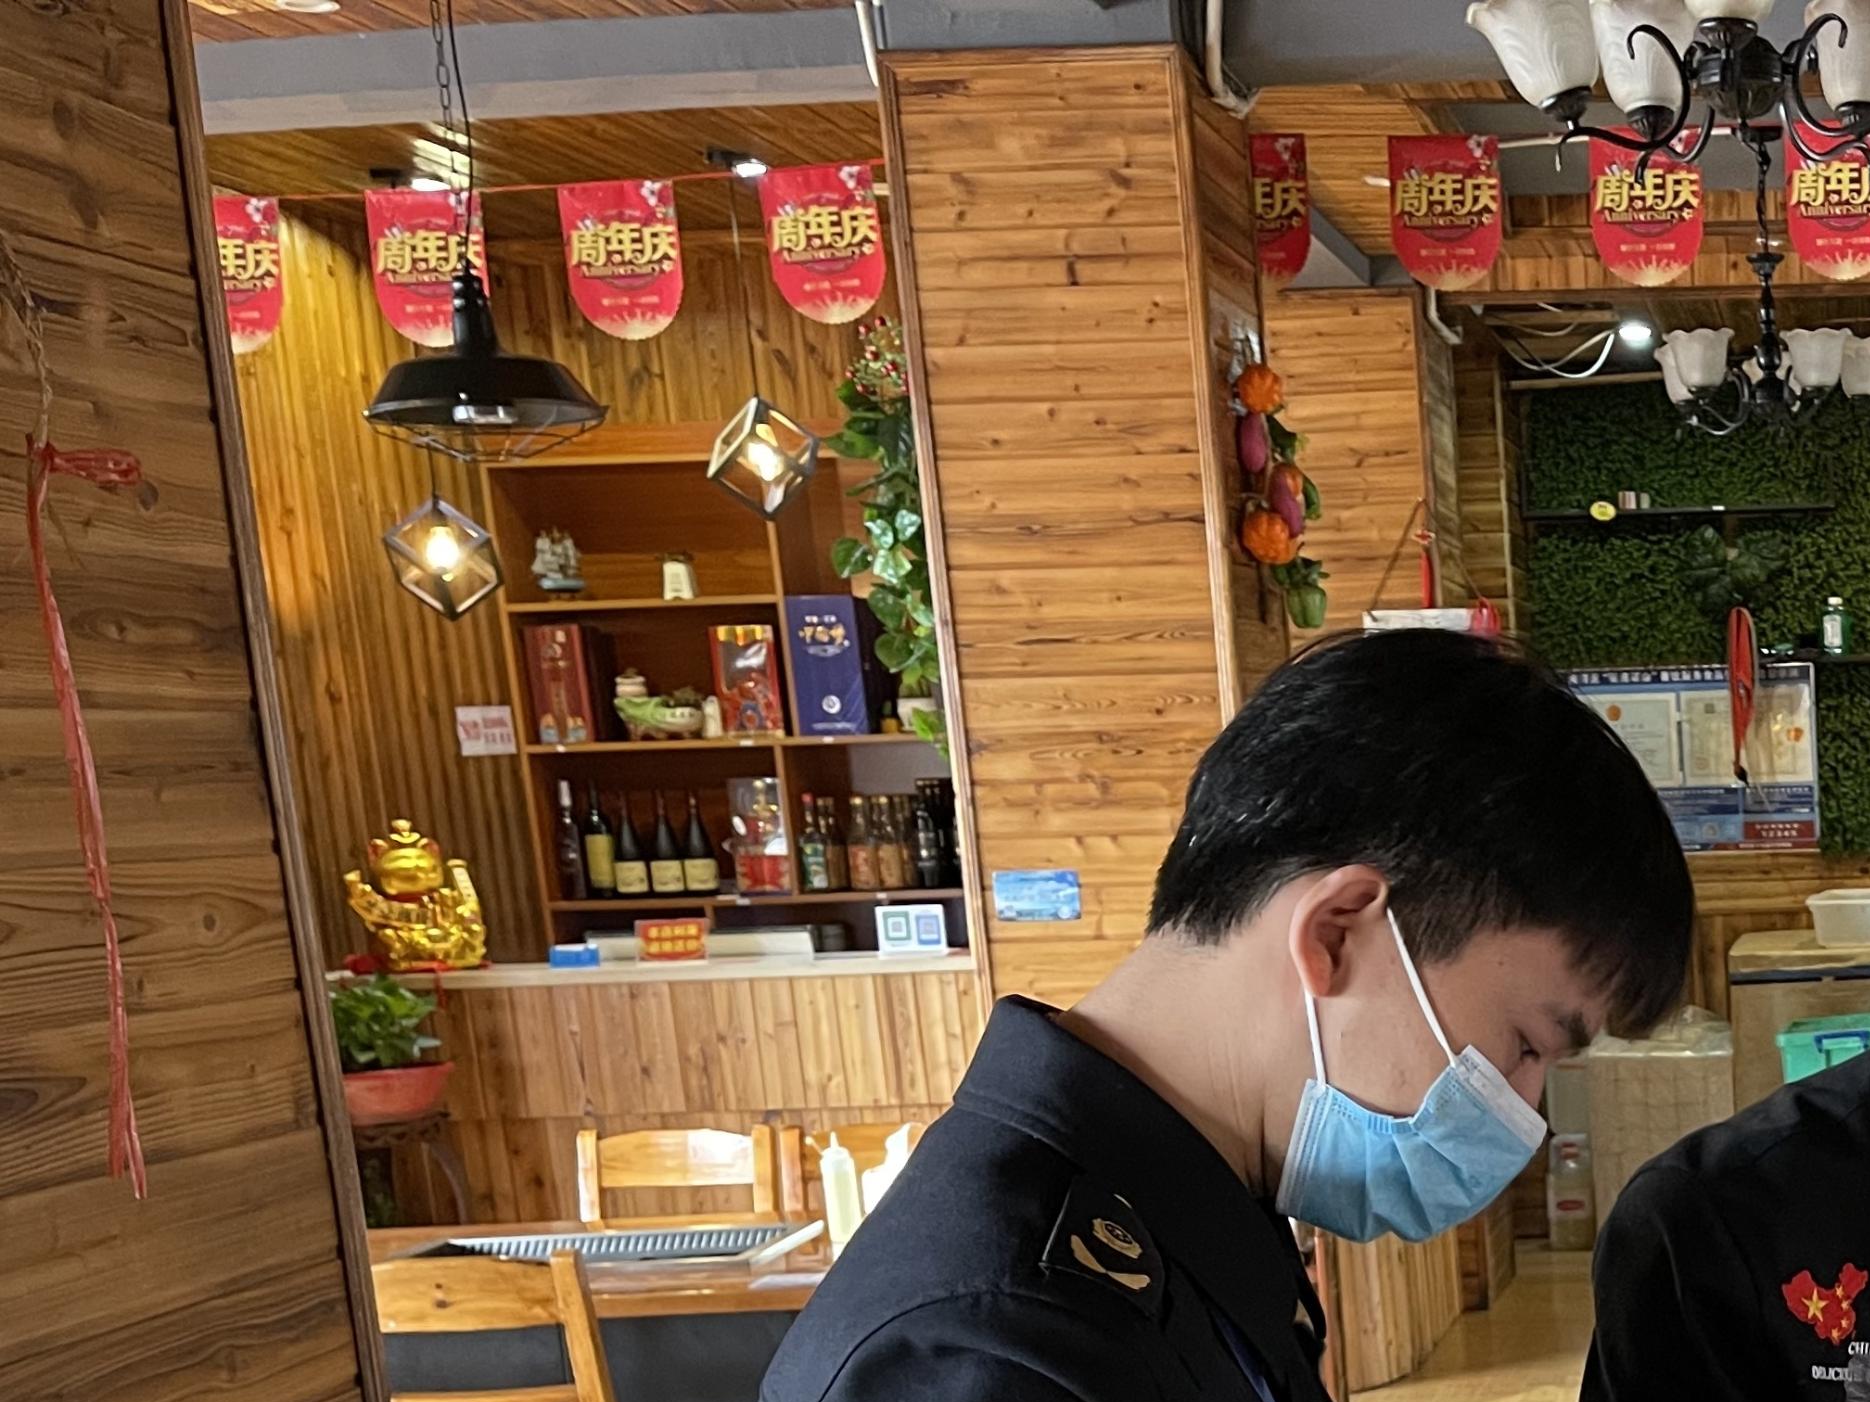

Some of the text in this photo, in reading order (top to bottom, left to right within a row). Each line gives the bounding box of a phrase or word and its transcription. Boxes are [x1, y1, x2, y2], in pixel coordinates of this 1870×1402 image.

[1395, 172, 1499, 217] 周年庆
[1594, 168, 1701, 212] 周年庆
[772, 205, 878, 252] 周年庆
[1604, 210, 1678, 224] Anniversary
[376, 230, 483, 275] 周年庆
[570, 222, 677, 266] 周年庆
